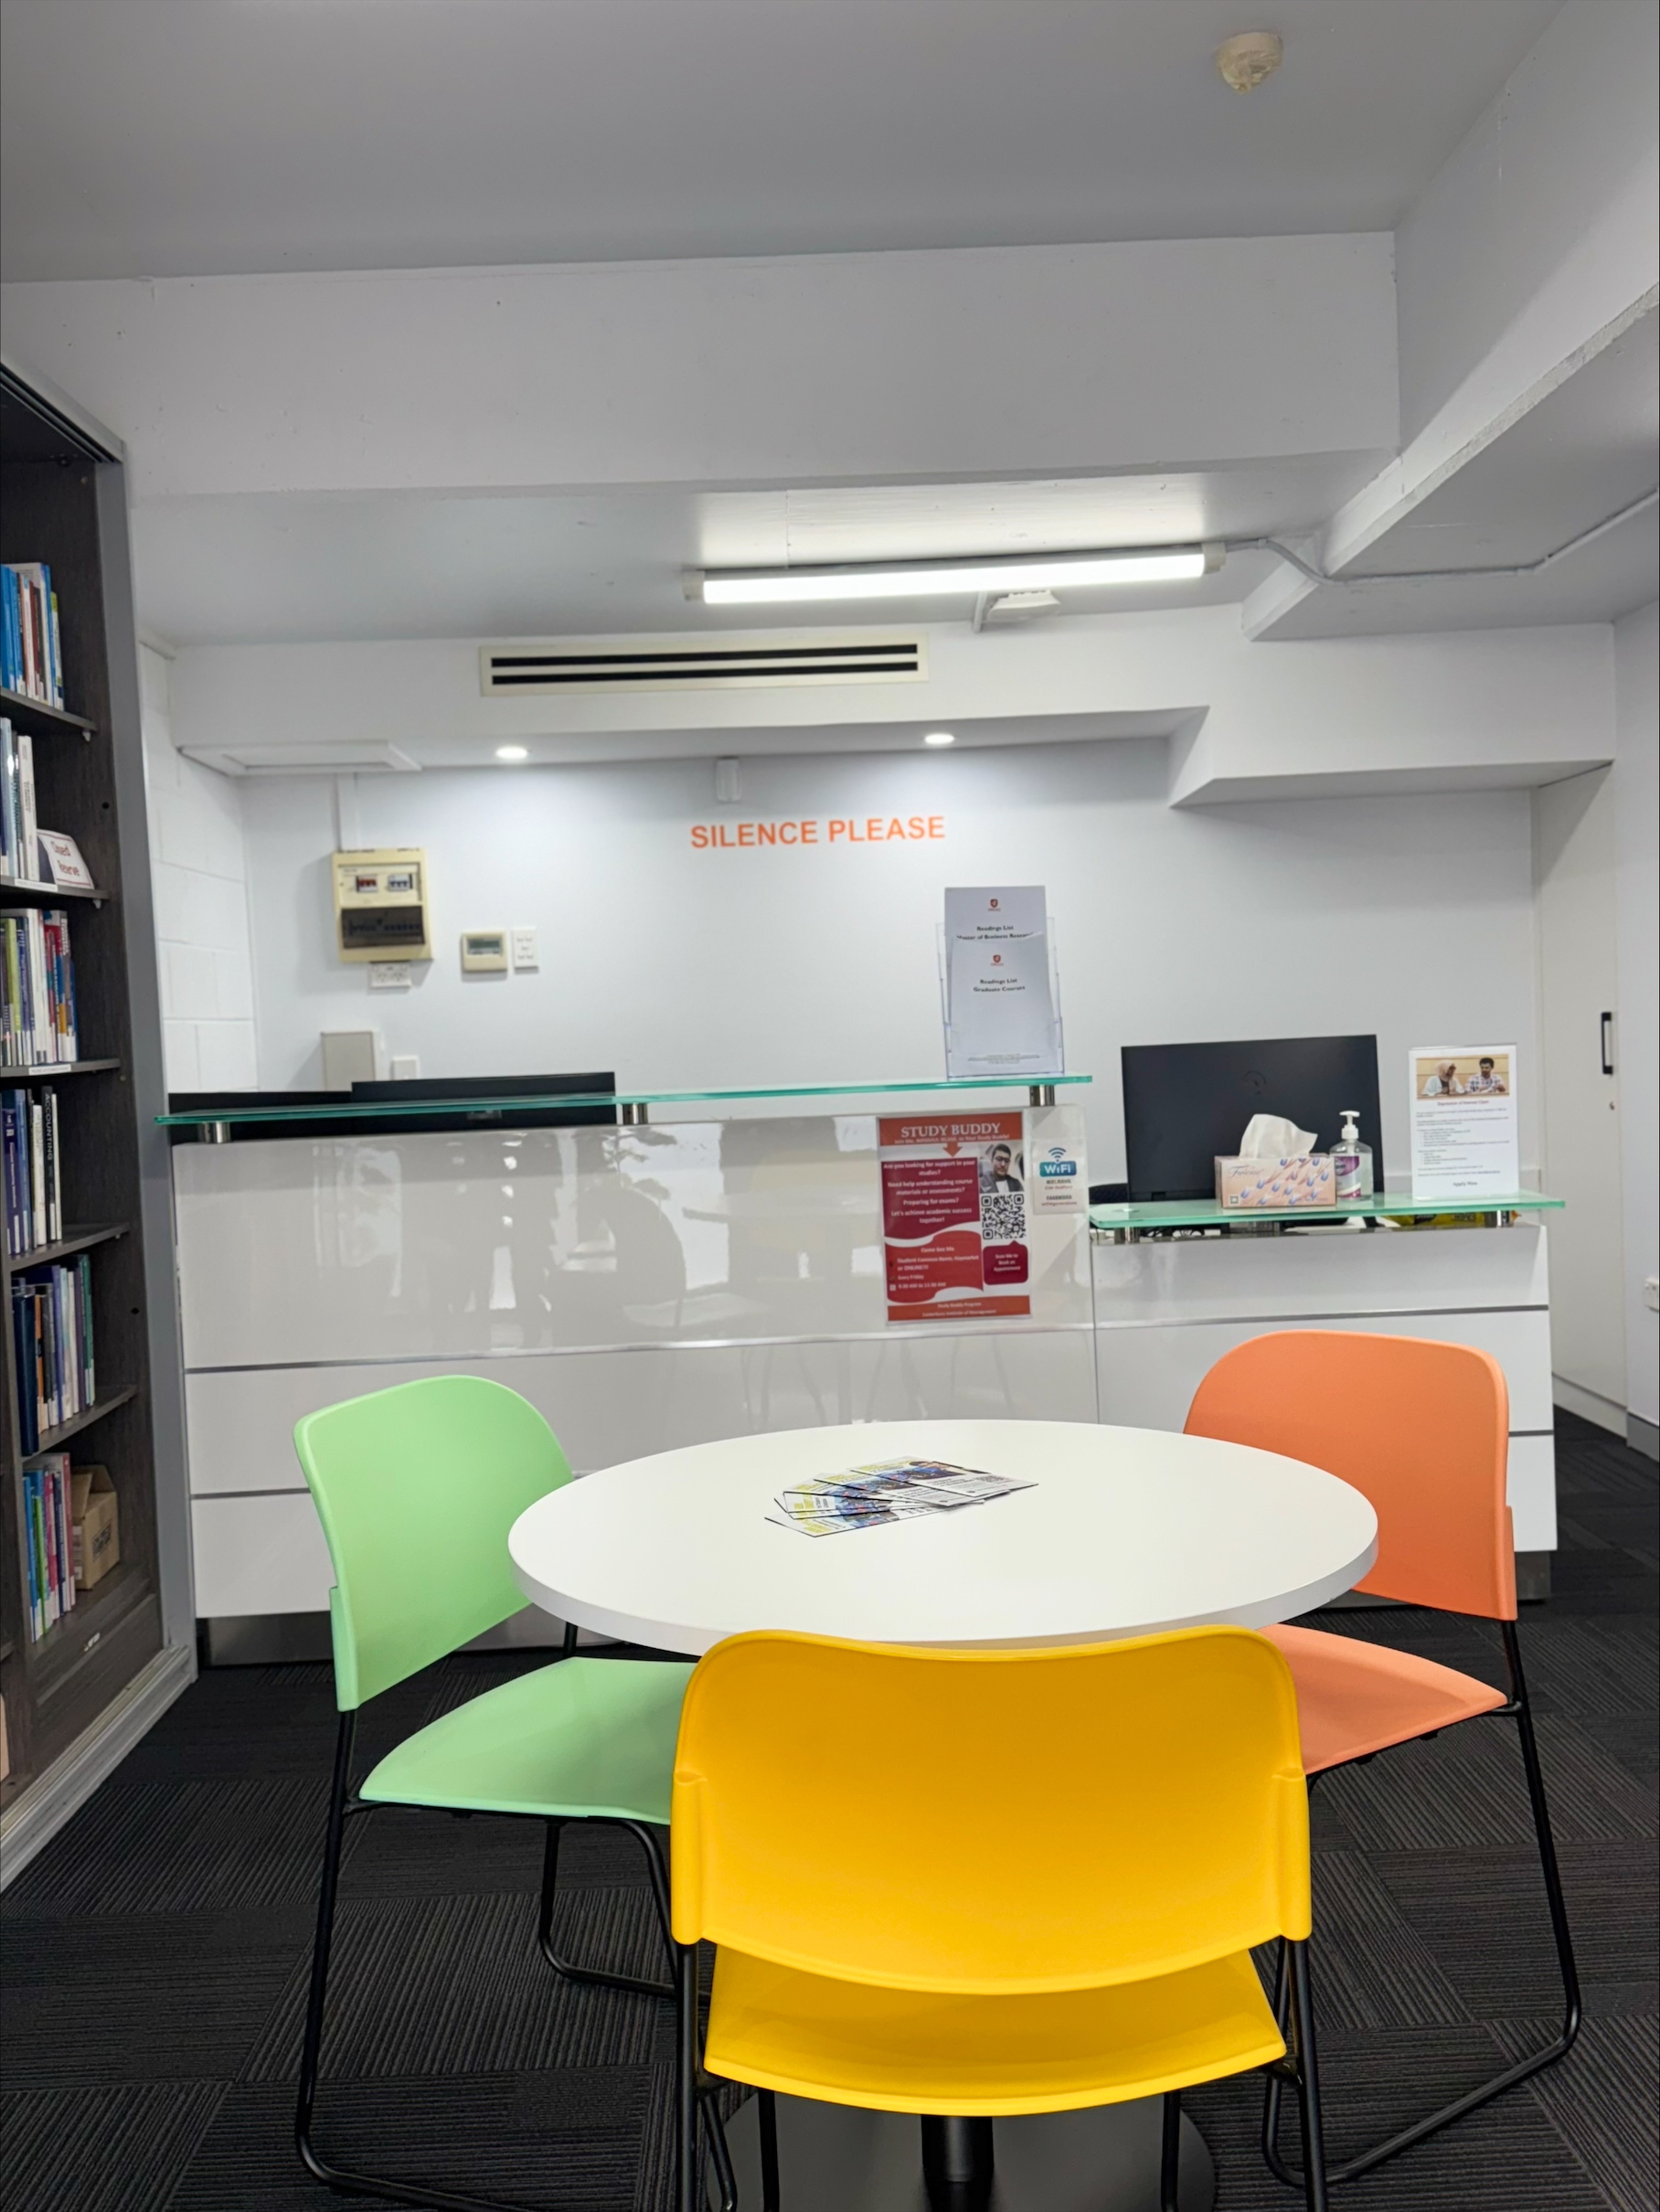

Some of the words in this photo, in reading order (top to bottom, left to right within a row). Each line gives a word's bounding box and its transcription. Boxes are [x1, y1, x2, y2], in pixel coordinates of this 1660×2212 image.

[690, 821, 818, 848] SILENCE
[828, 816, 945, 843] PLEASE
[45, 1093, 53, 1161] ACCOUNTING
[901, 1124, 948, 1138] STUDY
[951, 1122, 1000, 1135] BUDDY
[1044, 1164, 1071, 1175] WiFi
